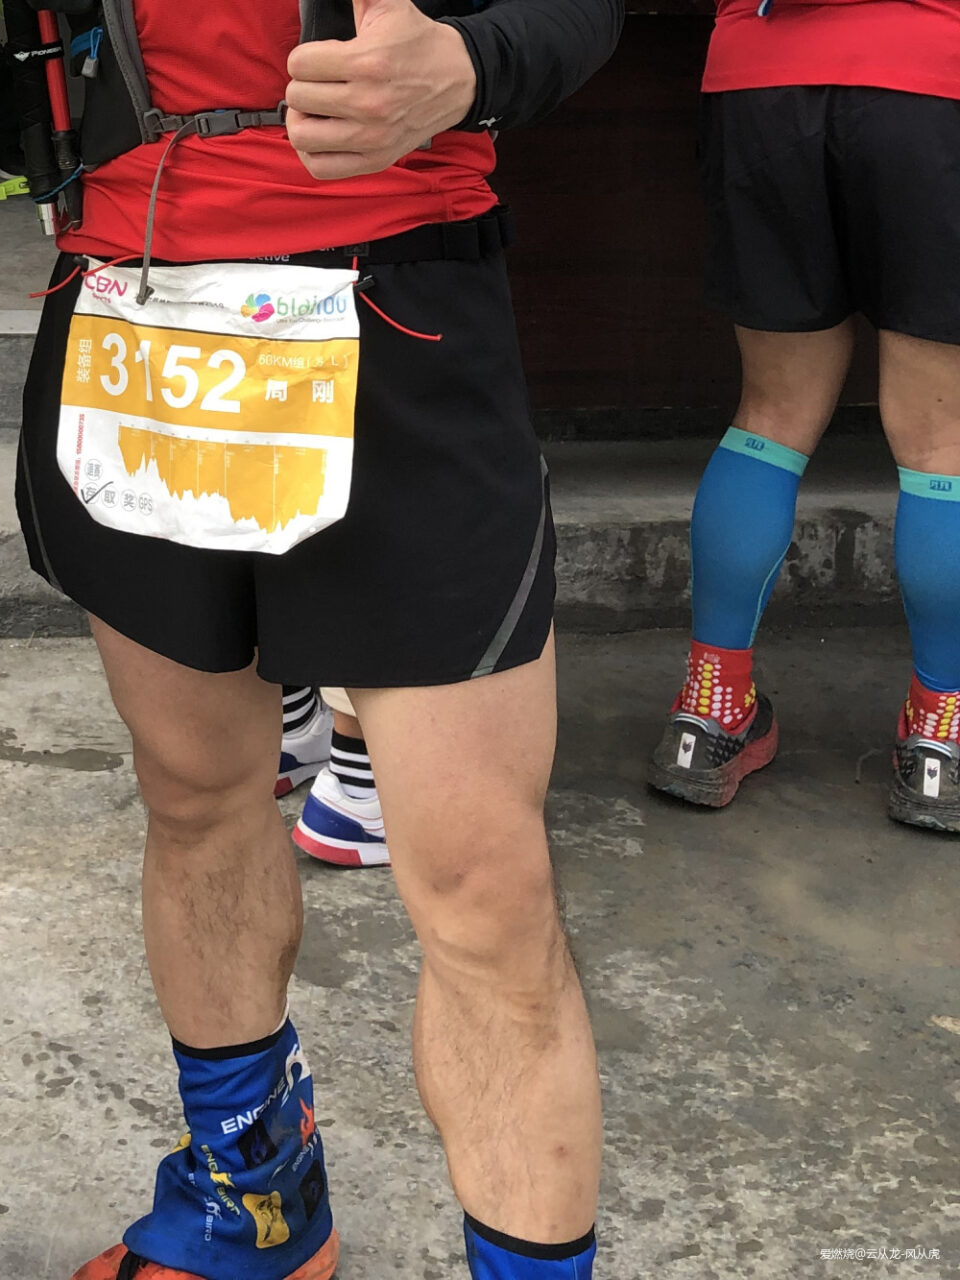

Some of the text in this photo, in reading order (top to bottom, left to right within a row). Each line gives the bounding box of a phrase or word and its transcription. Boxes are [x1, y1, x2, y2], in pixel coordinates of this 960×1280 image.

[84, 274, 128, 297] CBN
[100, 332, 246, 414] 3152
[220, 1076, 287, 1135] ENGINE
